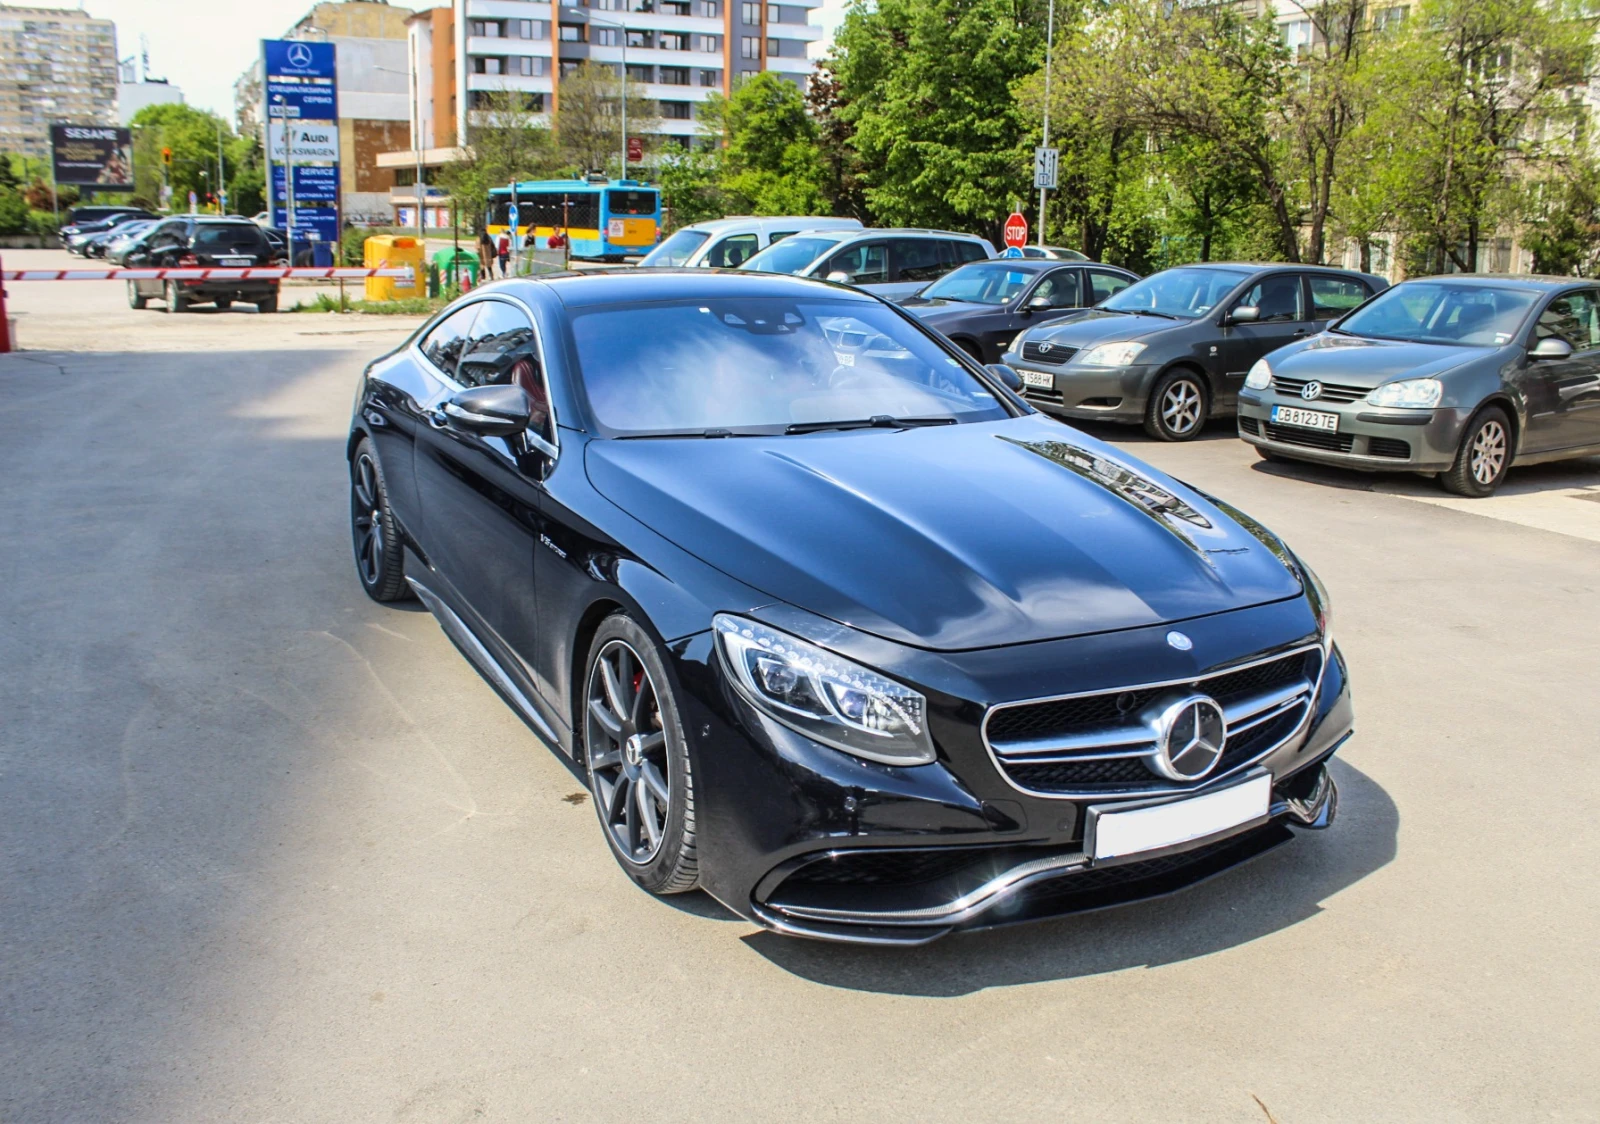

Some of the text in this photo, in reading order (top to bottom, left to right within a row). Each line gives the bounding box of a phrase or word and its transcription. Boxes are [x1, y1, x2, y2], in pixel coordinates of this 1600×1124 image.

[303, 95, 332, 104] СЕРВИЗ
[64, 127, 117, 140] SESAME
[300, 167, 335, 176] SERVICE
[1006, 226, 1026, 241] STOP
[1278, 408, 1336, 429] CB 8123 TE
